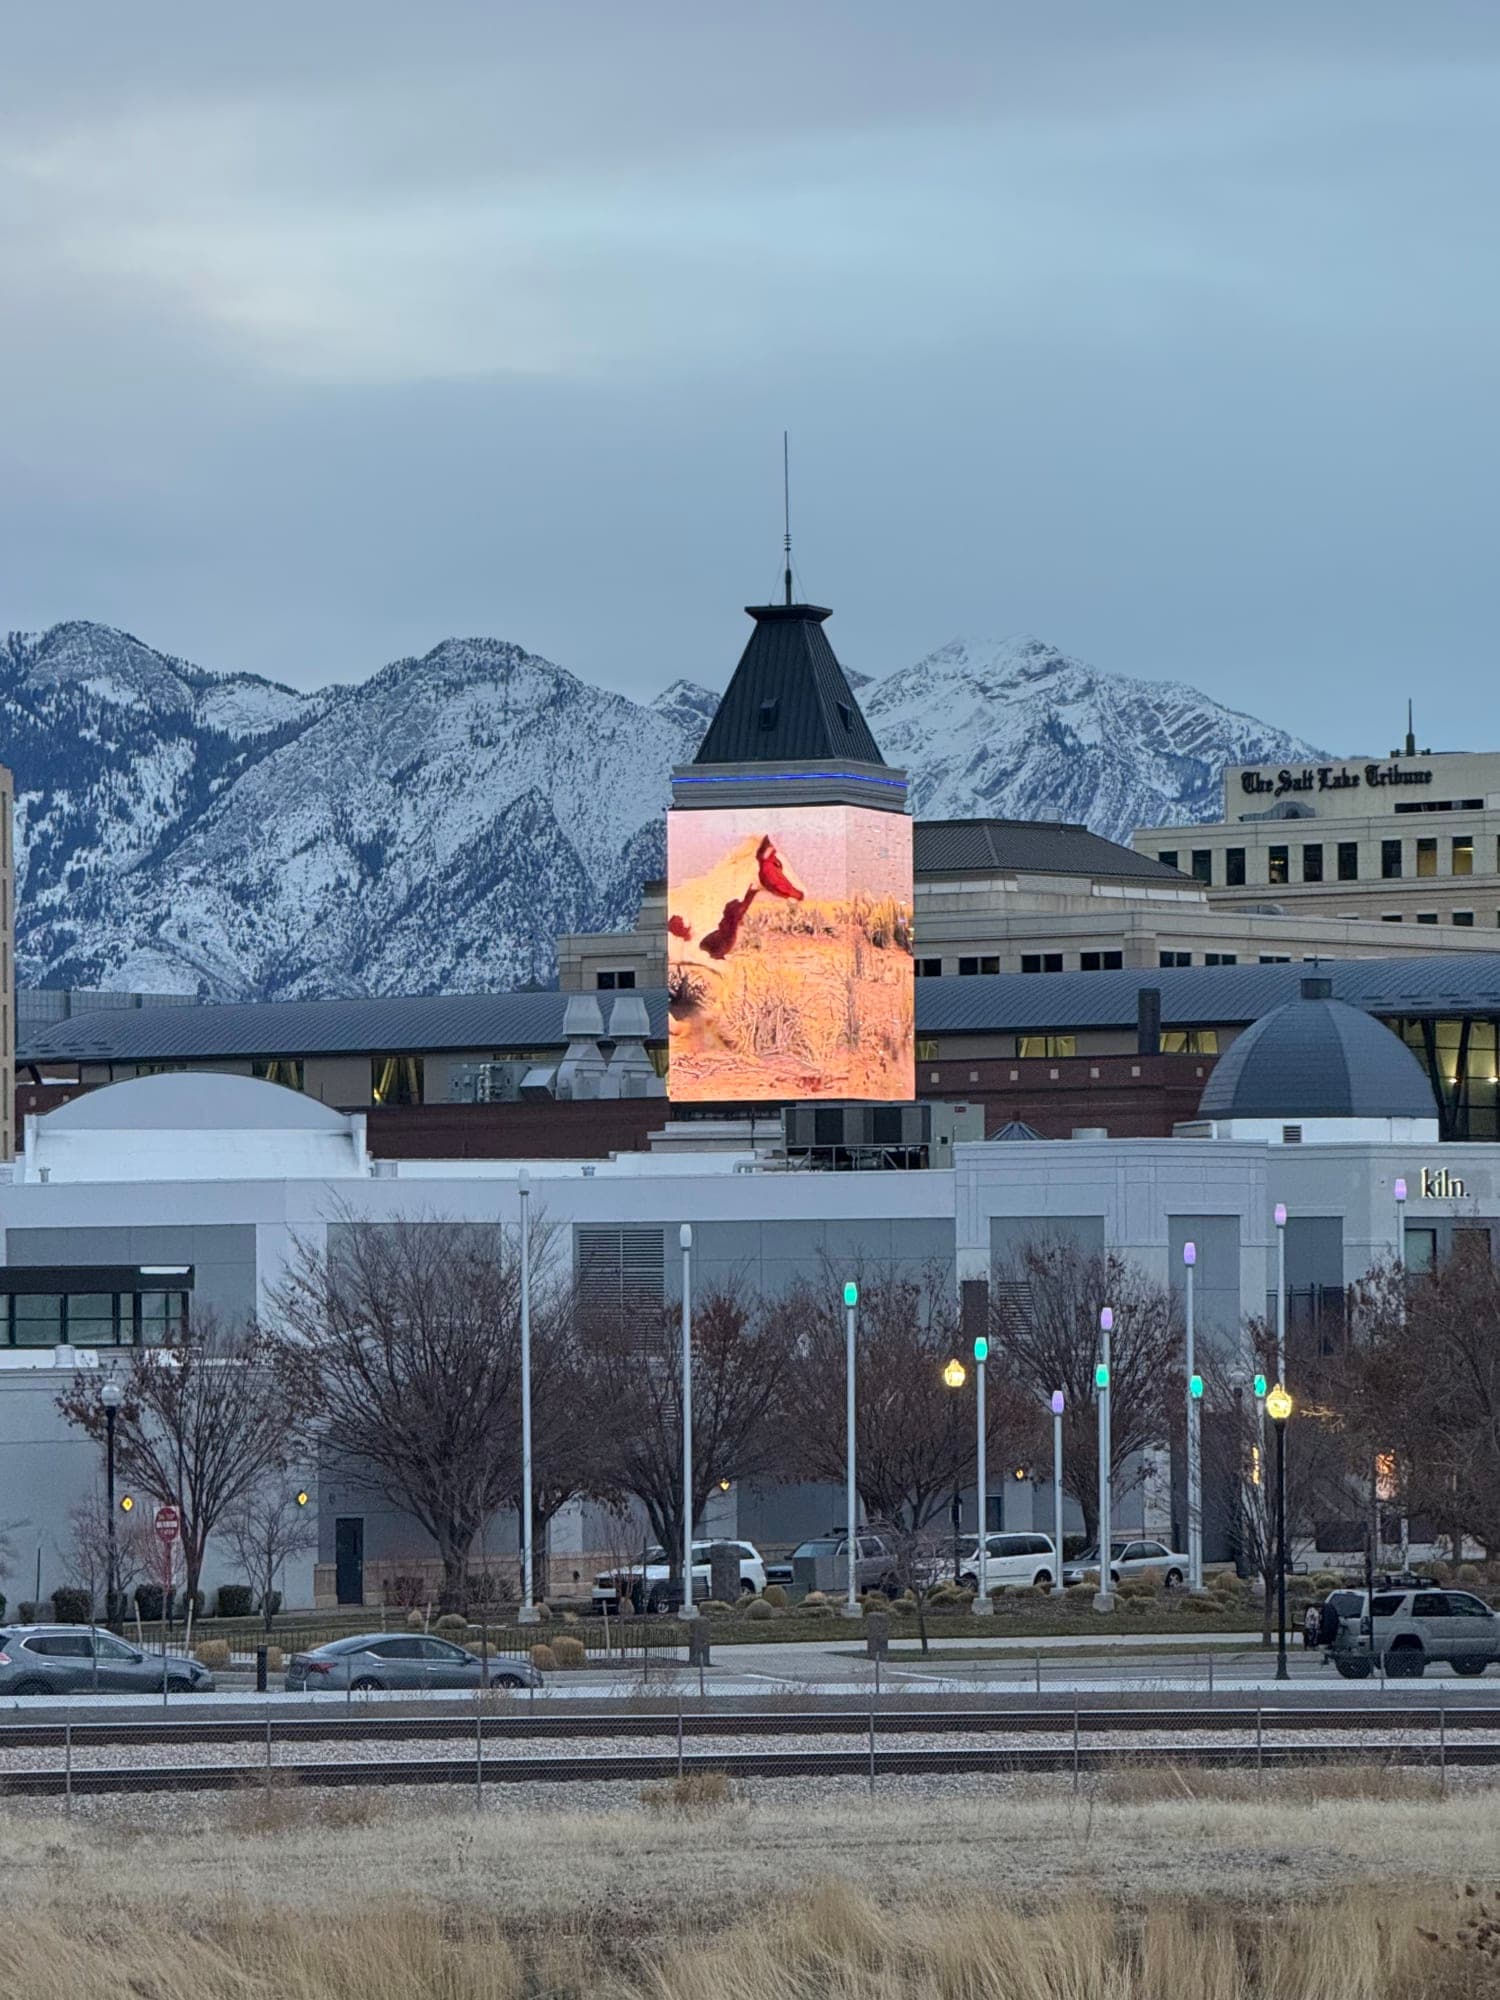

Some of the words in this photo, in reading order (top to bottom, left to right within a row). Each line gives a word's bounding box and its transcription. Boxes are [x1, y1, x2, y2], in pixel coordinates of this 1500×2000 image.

[1241, 771, 1274, 794] The
[1274, 769, 1314, 797] Salt
[1316, 767, 1360, 792] Lake
[1364, 763, 1433, 787] Tribune
